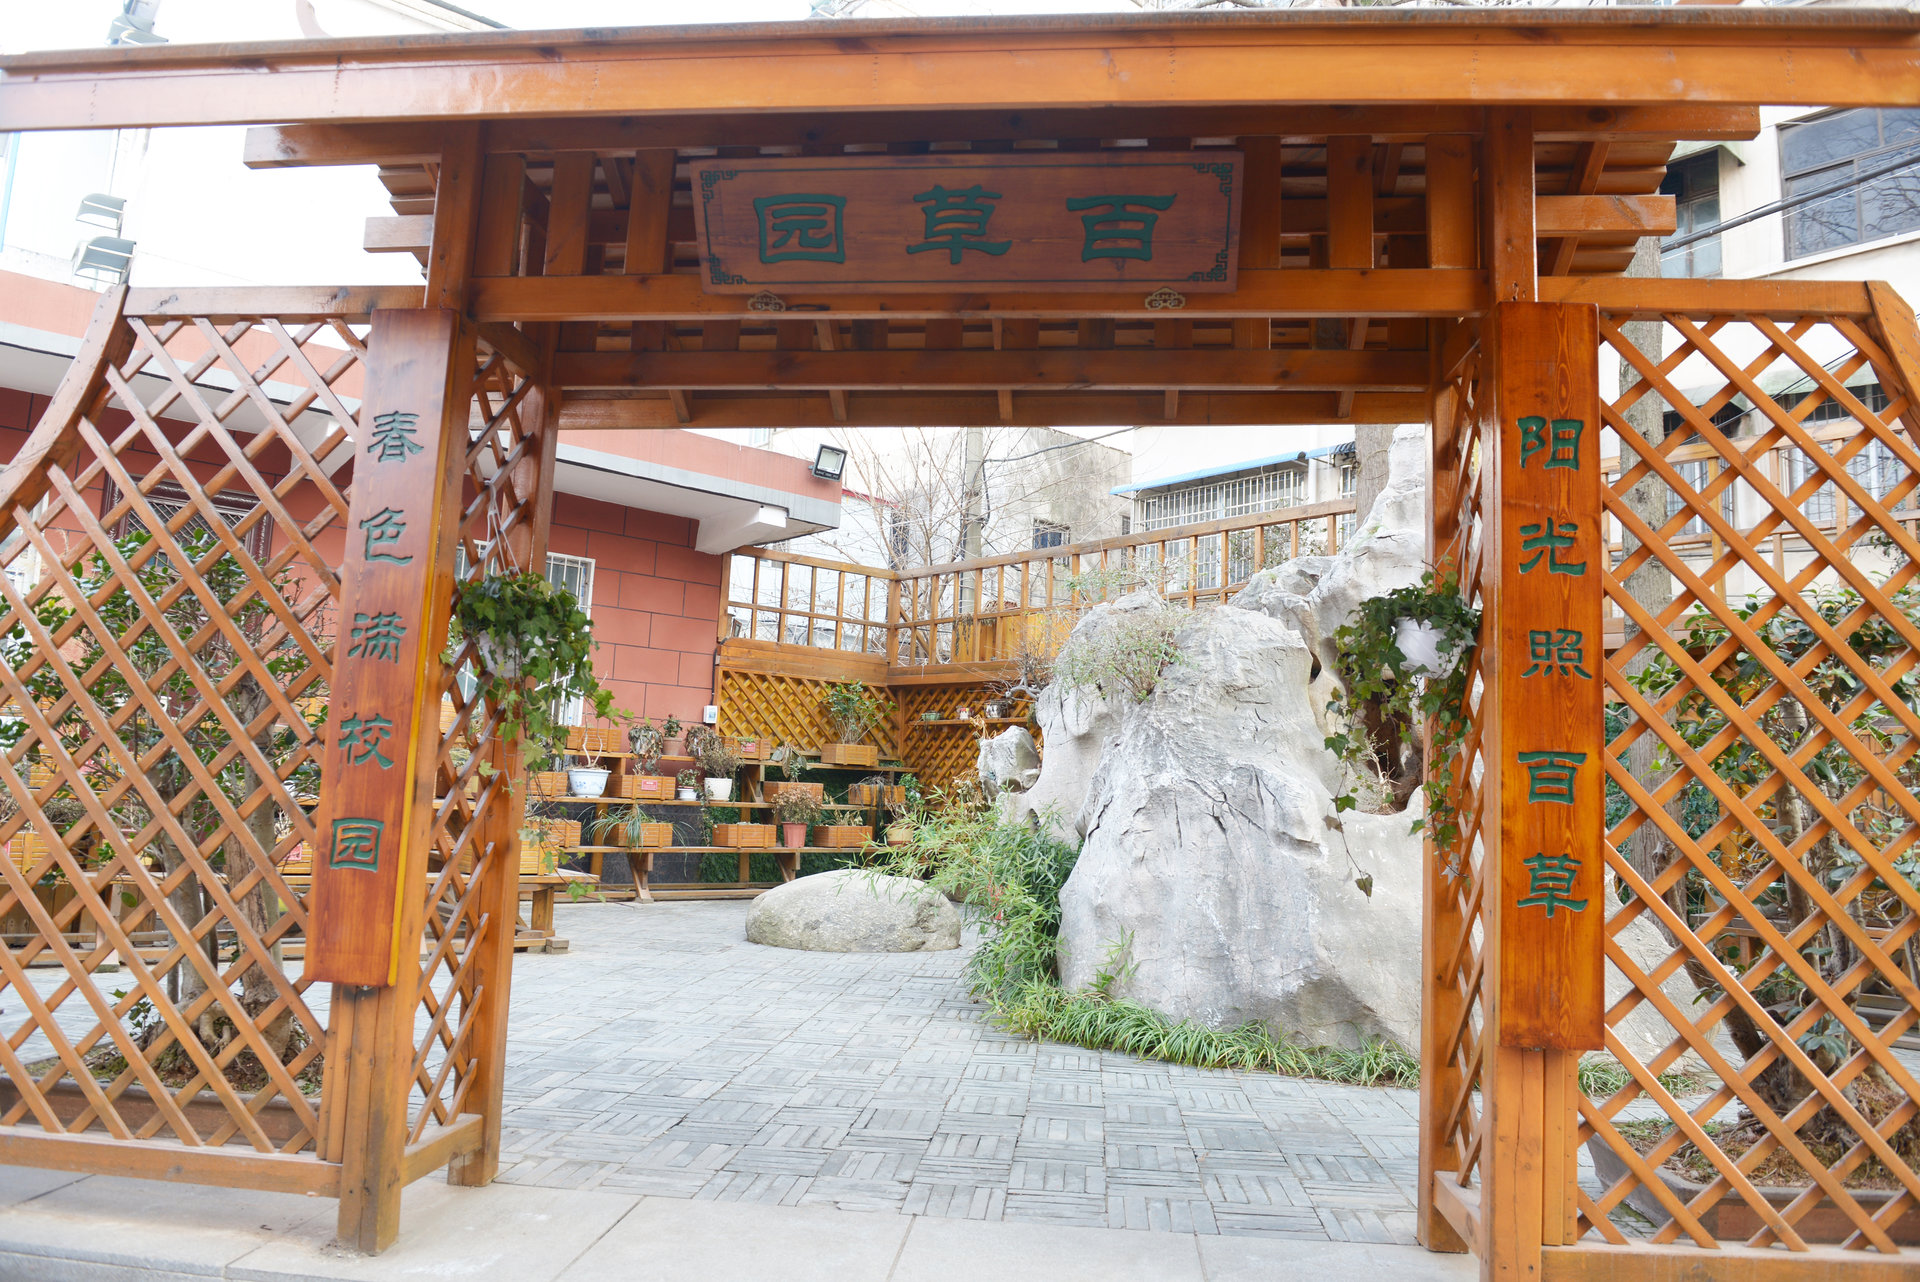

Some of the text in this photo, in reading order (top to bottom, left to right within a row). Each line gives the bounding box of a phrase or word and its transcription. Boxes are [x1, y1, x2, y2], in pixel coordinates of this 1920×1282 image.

[753, 184, 1177, 265] 百草园
[329, 410, 425, 873] 春色满校园
[1517, 416, 1593, 918] 阳光照百草
